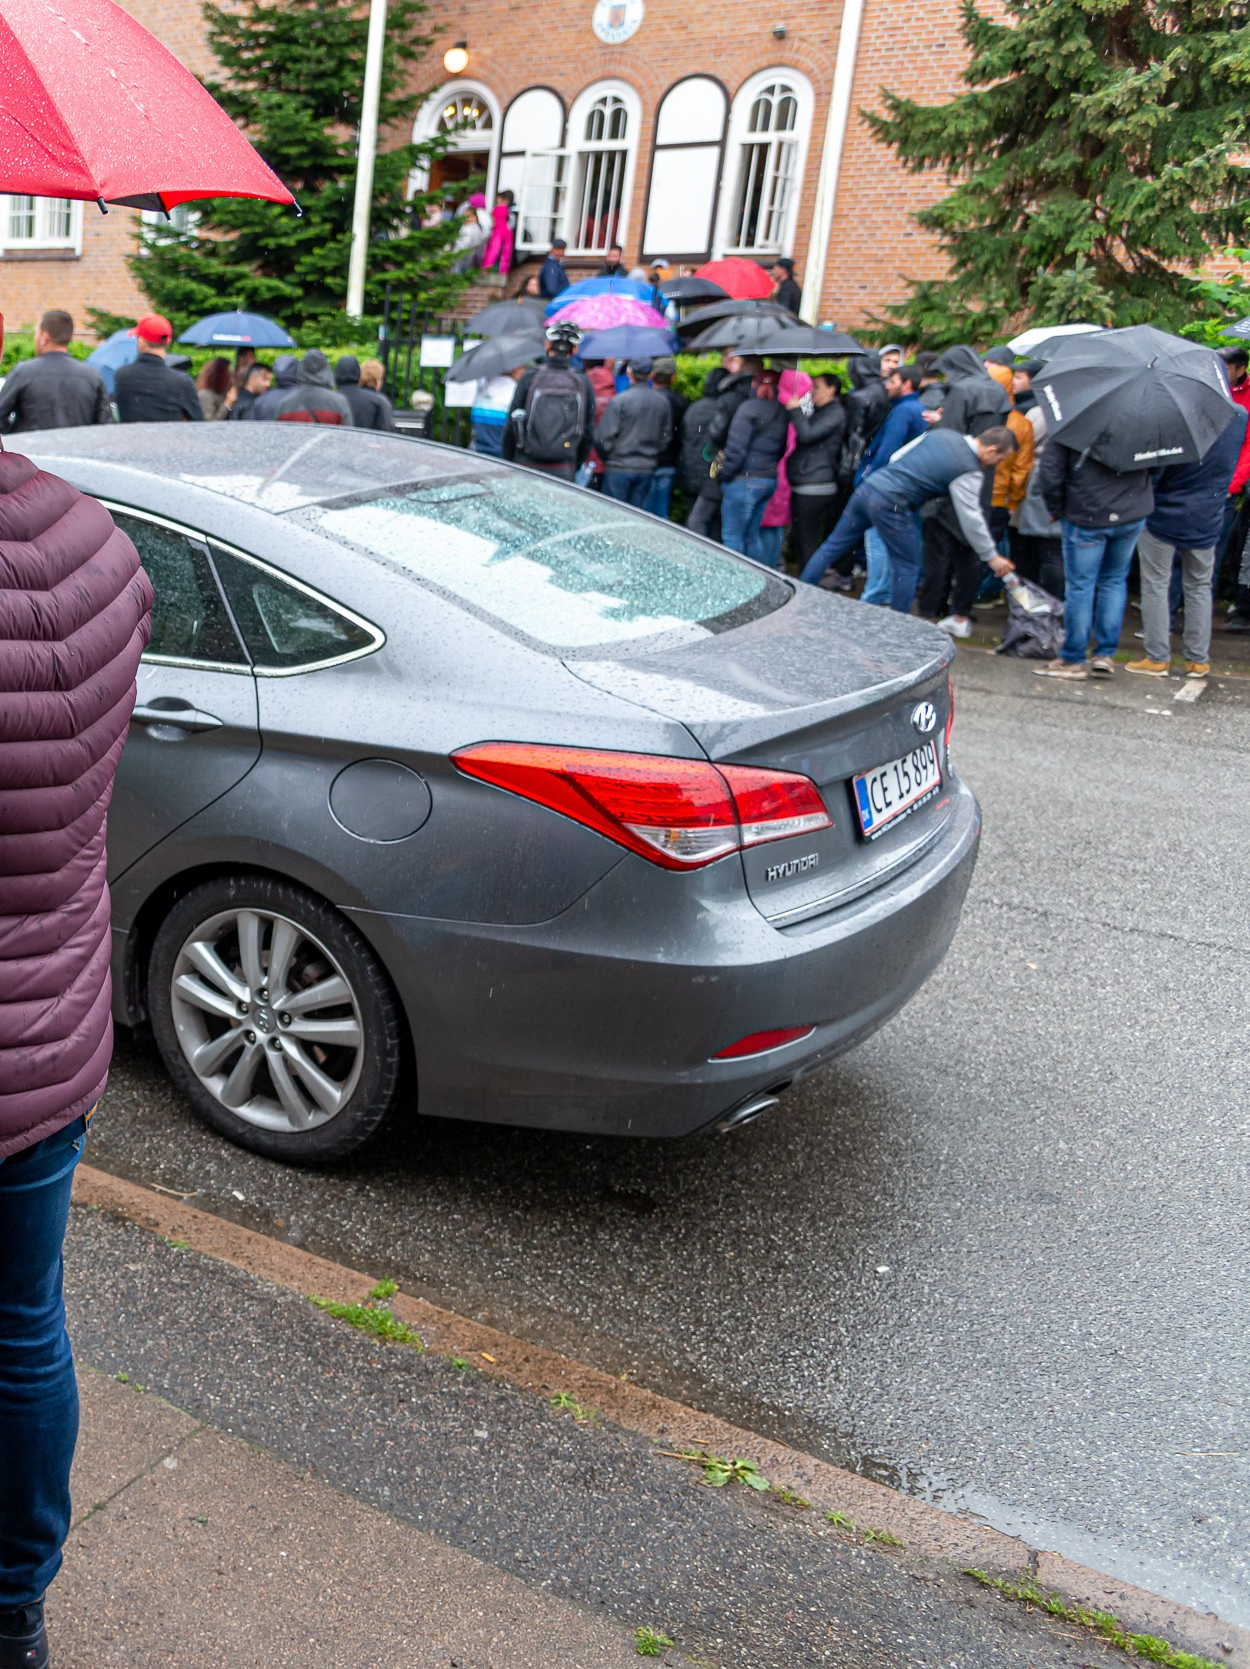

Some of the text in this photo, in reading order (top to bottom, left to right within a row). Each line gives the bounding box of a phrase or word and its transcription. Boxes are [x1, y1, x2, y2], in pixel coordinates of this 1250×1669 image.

[870, 770, 892, 814] CE
[893, 758, 912, 800] 15
[911, 742, 935, 787] 899
[765, 852, 819, 882] HYUNDAI
